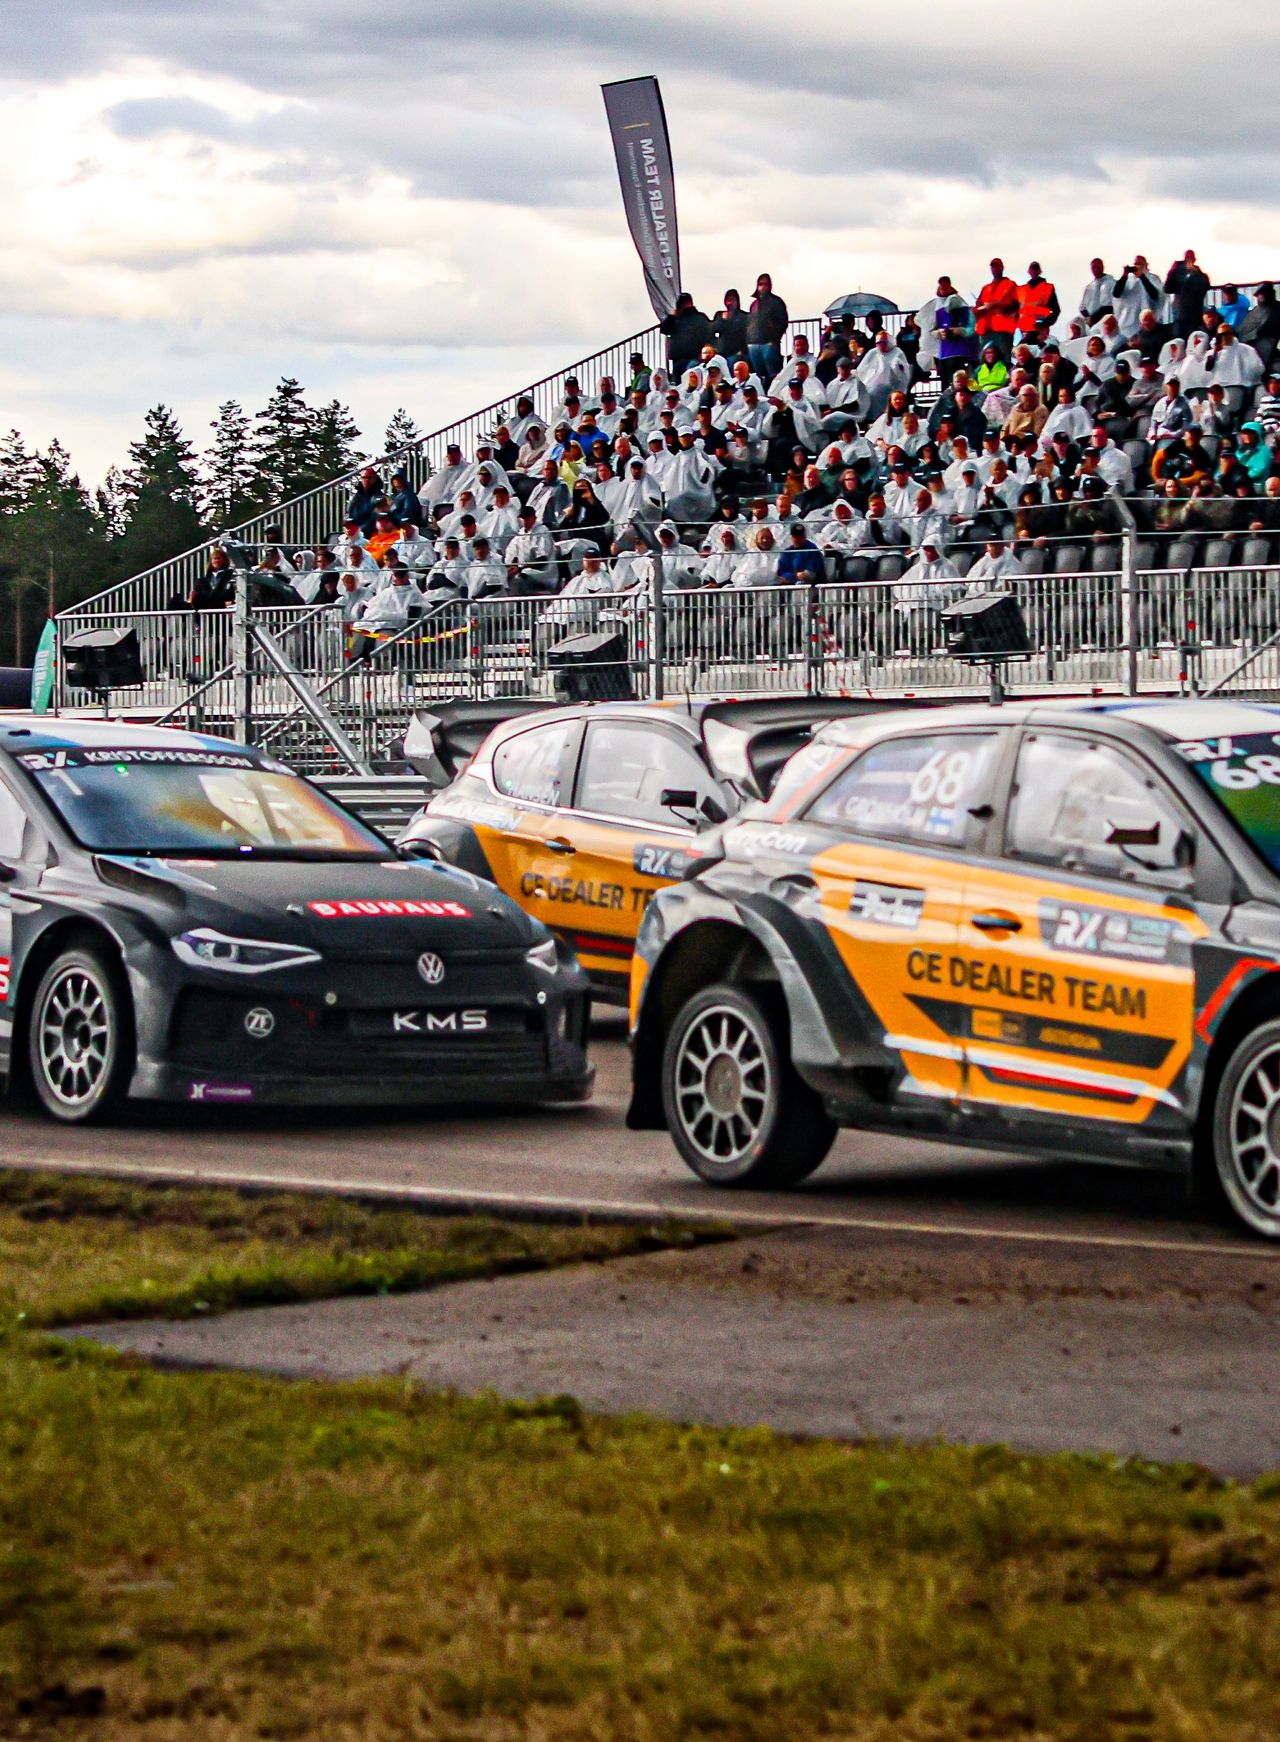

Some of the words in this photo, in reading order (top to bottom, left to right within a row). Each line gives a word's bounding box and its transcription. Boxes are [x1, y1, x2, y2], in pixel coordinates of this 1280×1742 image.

[83, 750, 254, 768] KRISTOFFERSSON
[49, 768, 85, 797] 1
[909, 748, 972, 806] 68
[548, 875, 625, 912] DEALER
[630, 887, 657, 913] TE
[312, 900, 468, 918] BAUHAUS
[906, 949, 943, 984] CE
[949, 957, 1057, 1005] DEALER
[1063, 975, 1148, 1020] TEAM
[393, 1009, 488, 1031] KMS
